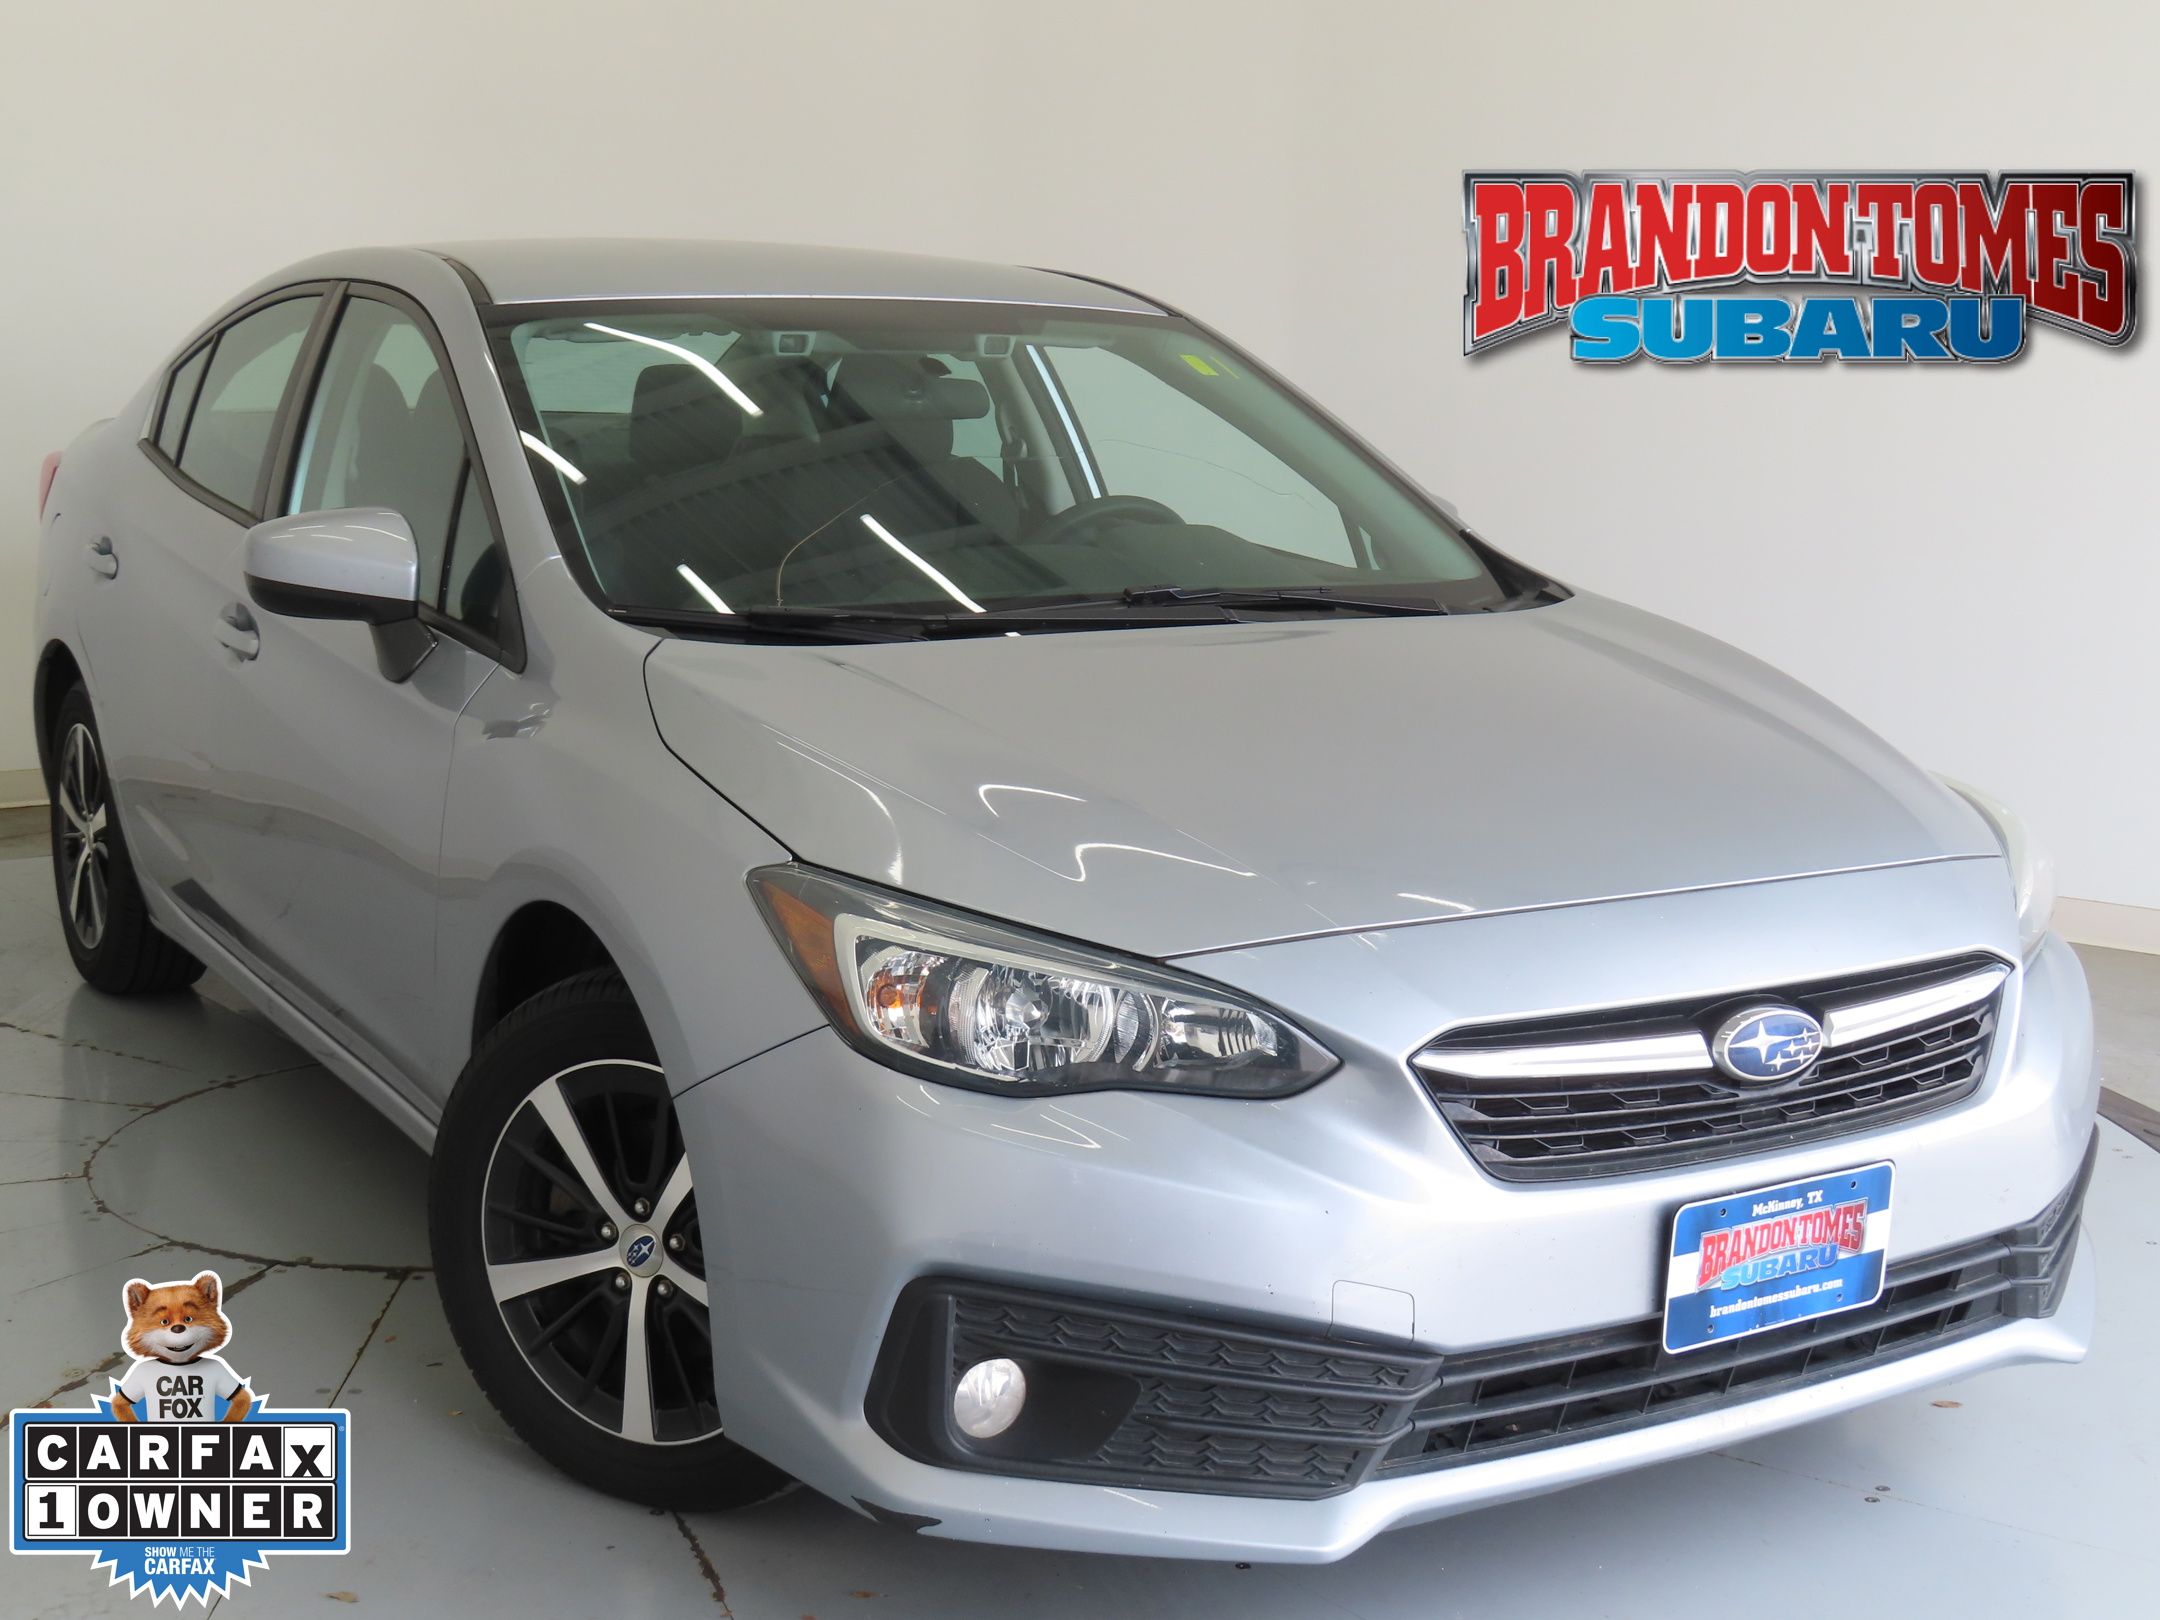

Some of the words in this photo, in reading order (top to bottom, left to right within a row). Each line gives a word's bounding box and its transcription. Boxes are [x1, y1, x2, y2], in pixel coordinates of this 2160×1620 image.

[1752, 1197, 1804, 1217] McKinney,
[1807, 1190, 1823, 1204] TX
[1698, 1215, 1800, 1289] BRANDON
[1799, 1200, 1867, 1252] TOMES
[1720, 1244, 1839, 1291] SUBARU
[1709, 1278, 1843, 1319] brandontomessubaru.com
